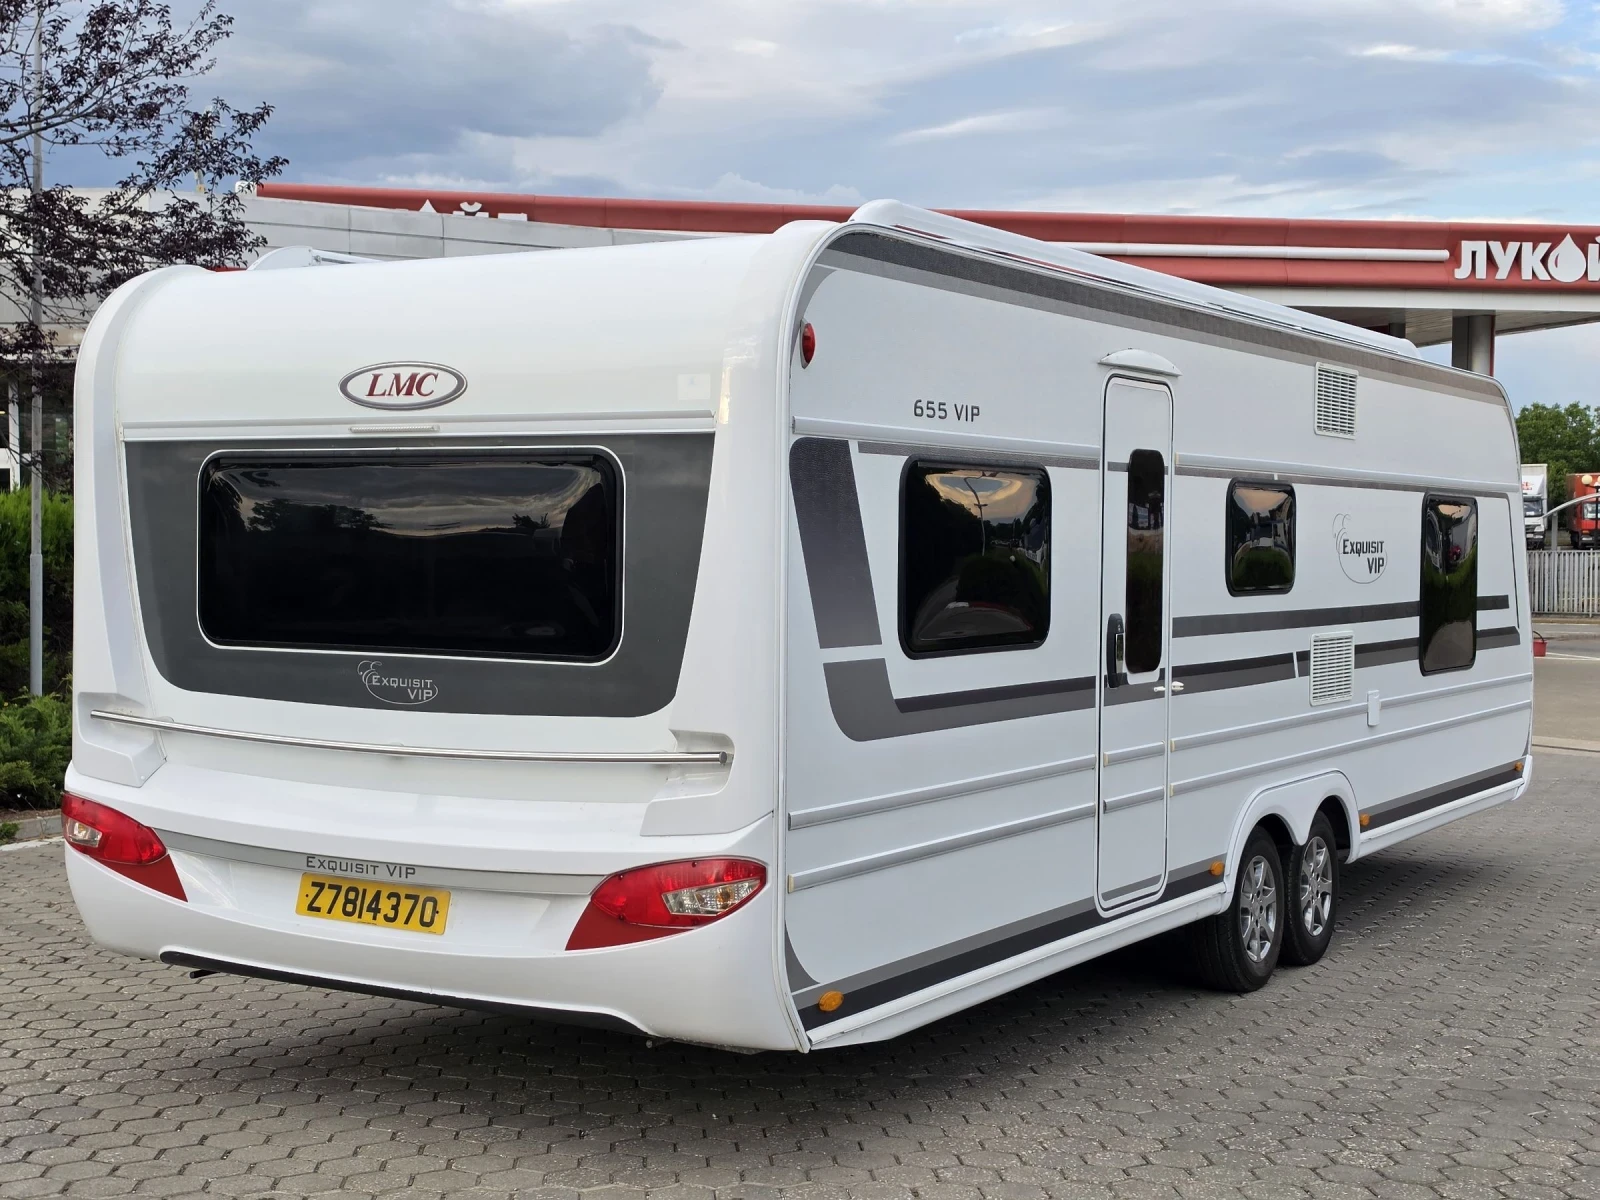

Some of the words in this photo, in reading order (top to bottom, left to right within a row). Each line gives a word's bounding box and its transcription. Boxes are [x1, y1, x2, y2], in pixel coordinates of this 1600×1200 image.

[365, 371, 439, 397] LMC
[913, 398, 948, 420] 655
[953, 403, 980, 422] VIP
[1342, 538, 1385, 557] EXQUISIT
[1366, 556, 1385, 575] VIP
[372, 675, 433, 689] EXQUISIT
[407, 688, 433, 701] VIP
[306, 855, 379, 874] EXQUISIT
[386, 864, 416, 879] VIP
[306, 880, 438, 928] Z7814370
